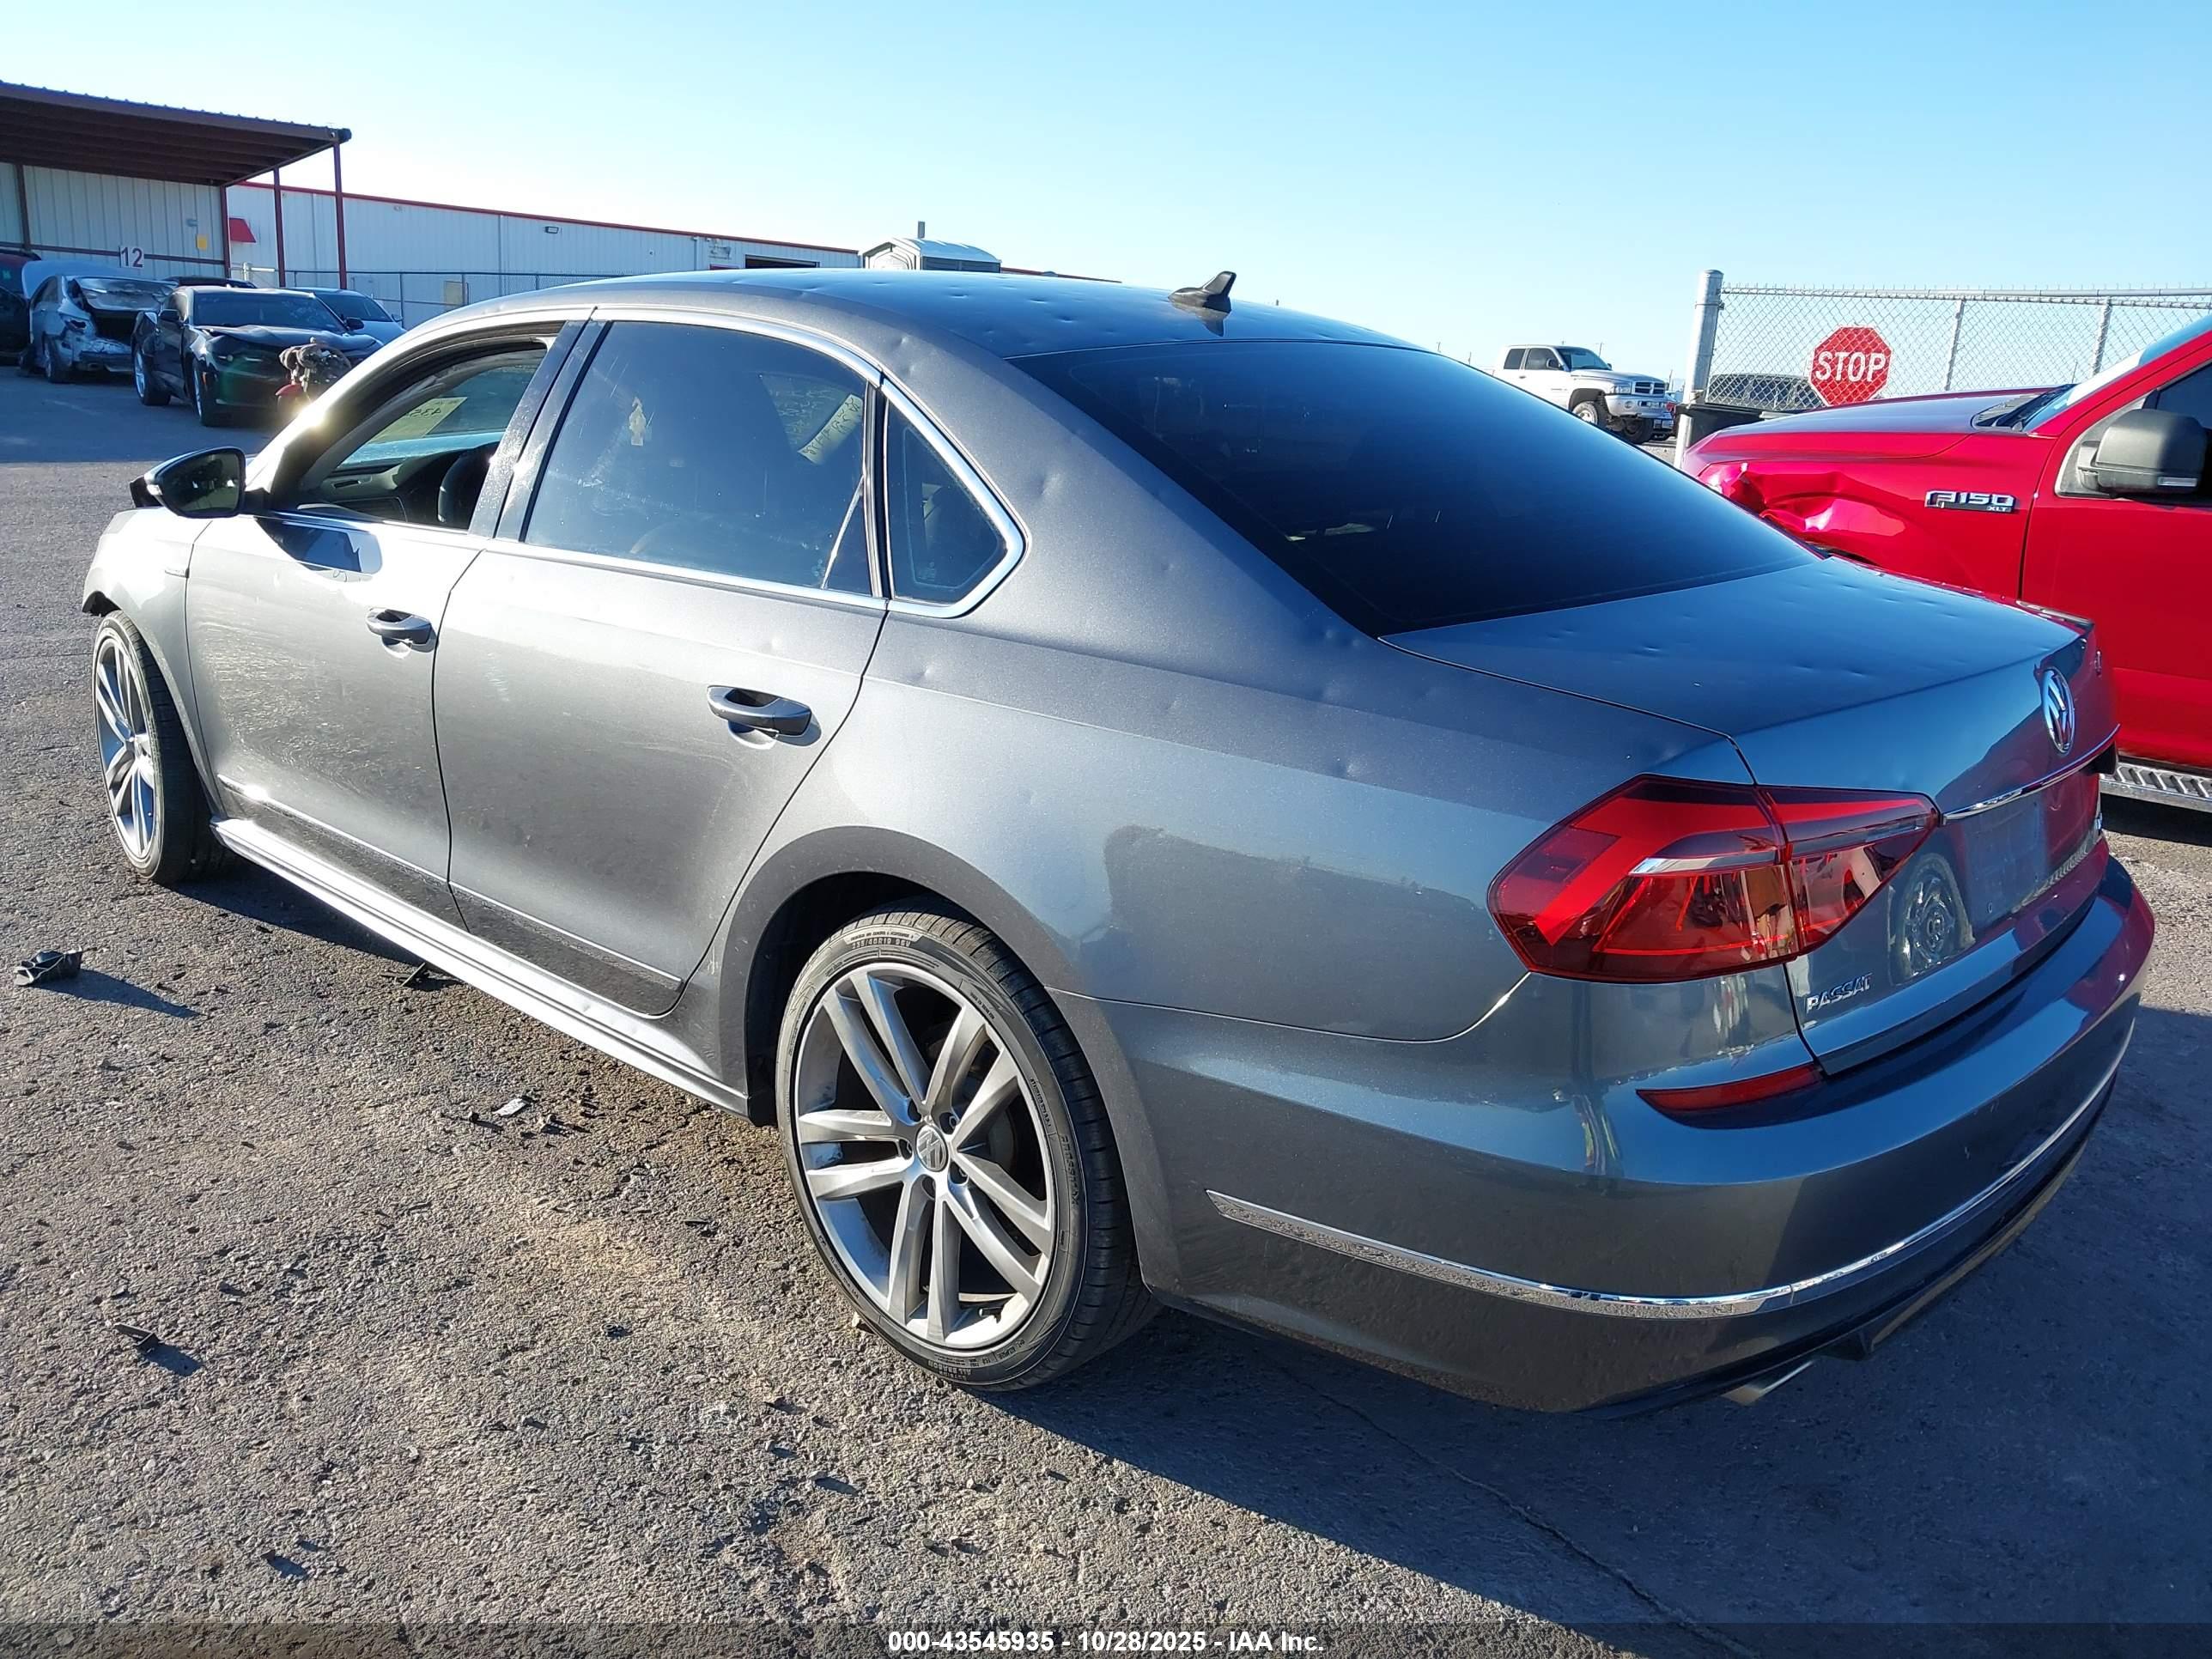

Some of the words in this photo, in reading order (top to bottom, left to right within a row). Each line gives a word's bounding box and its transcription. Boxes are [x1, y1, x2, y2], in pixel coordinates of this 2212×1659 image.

[120, 247, 143, 268] 12
[1815, 350, 1886, 382] STOP
[1806, 972, 1873, 1013] PASSAT
